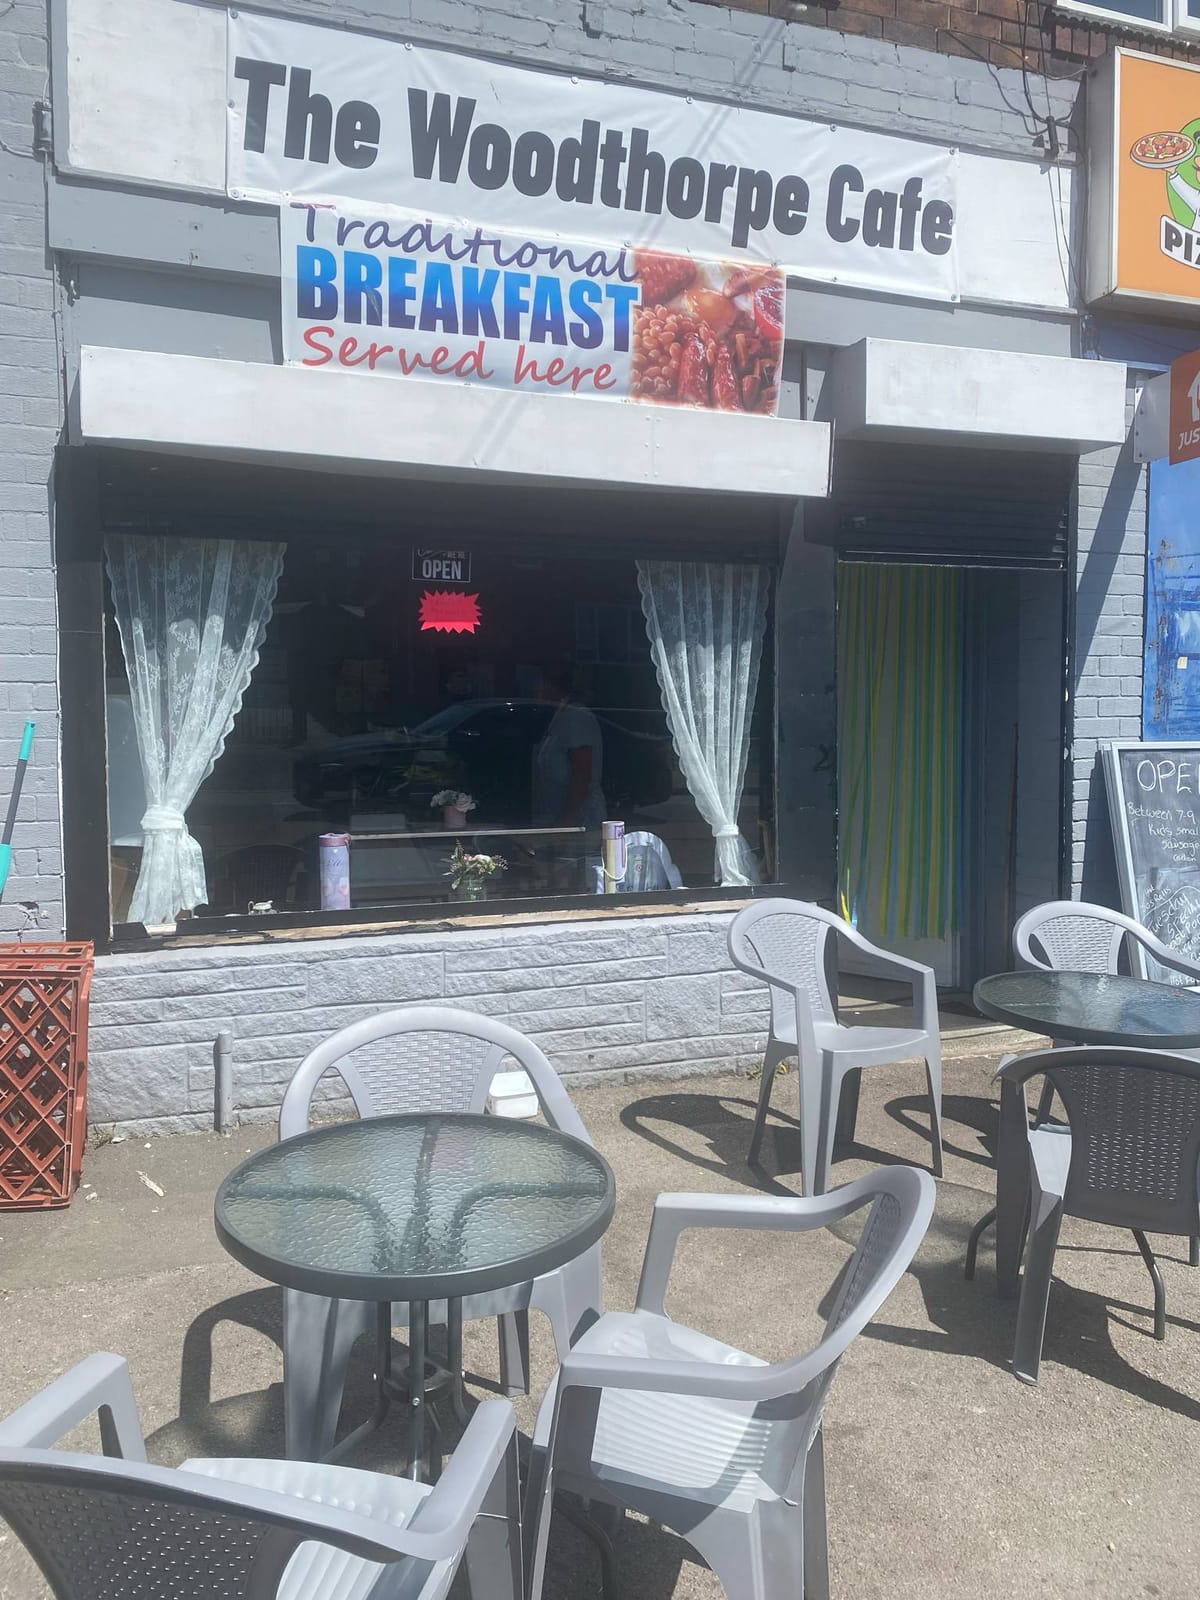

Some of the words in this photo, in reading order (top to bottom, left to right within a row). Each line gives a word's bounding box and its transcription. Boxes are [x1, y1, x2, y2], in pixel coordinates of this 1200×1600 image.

[234, 56, 381, 169] The
[407, 87, 809, 248] Woodthorpe
[825, 164, 953, 255] Cafe
[289, 201, 640, 282] Traditional
[297, 245, 639, 352] BREAKFAST
[302, 325, 494, 379] Served
[513, 343, 618, 391] here
[422, 559, 461, 580] OPEN
[1137, 759, 1200, 795] OPE
[1127, 801, 1172, 821] Between
[1176, 809, 1196, 825] 7-9
[1148, 823, 1173, 836] Kids
